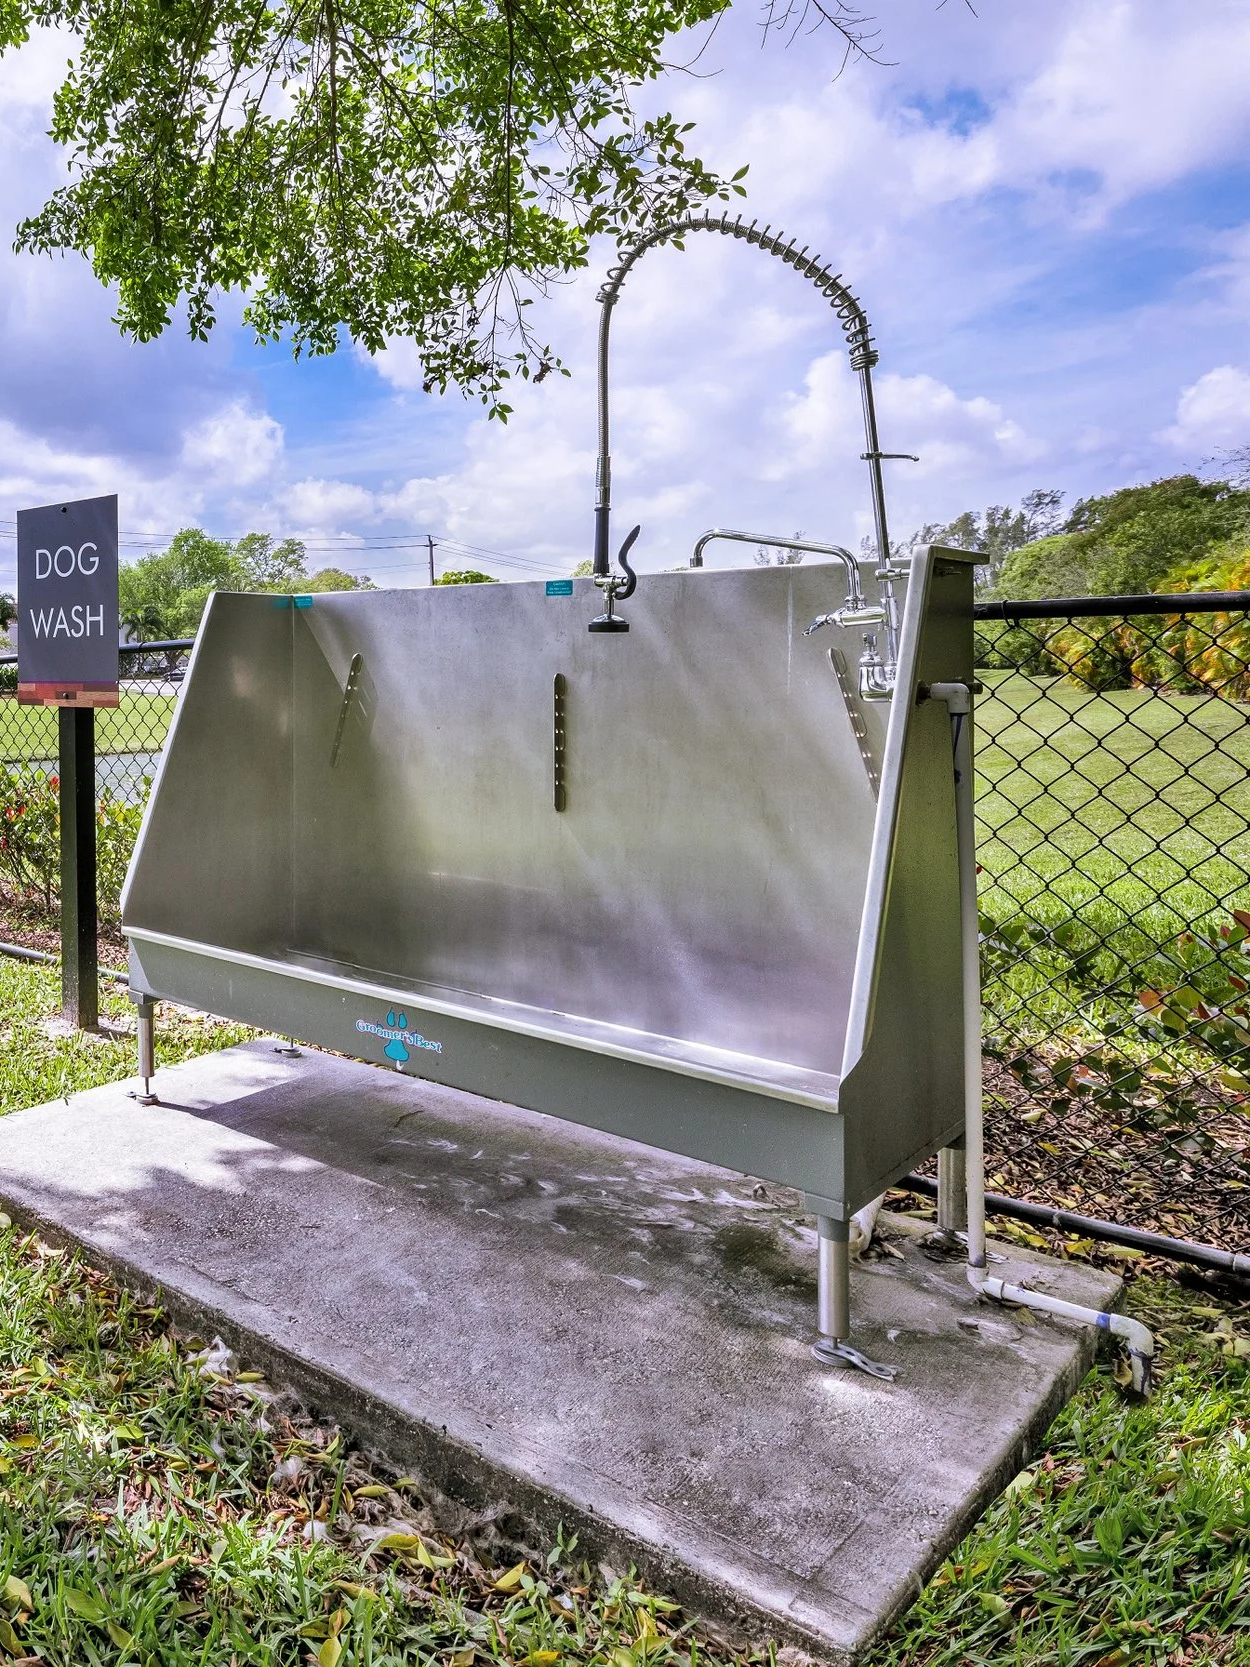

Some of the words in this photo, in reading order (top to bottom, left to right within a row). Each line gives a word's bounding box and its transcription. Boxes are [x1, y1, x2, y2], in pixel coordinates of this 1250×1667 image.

[35, 542, 100, 580] DOG
[29, 604, 104, 639] WASH
[356, 1020, 413, 1045] Groomer's
[413, 1033, 442, 1053] Best
